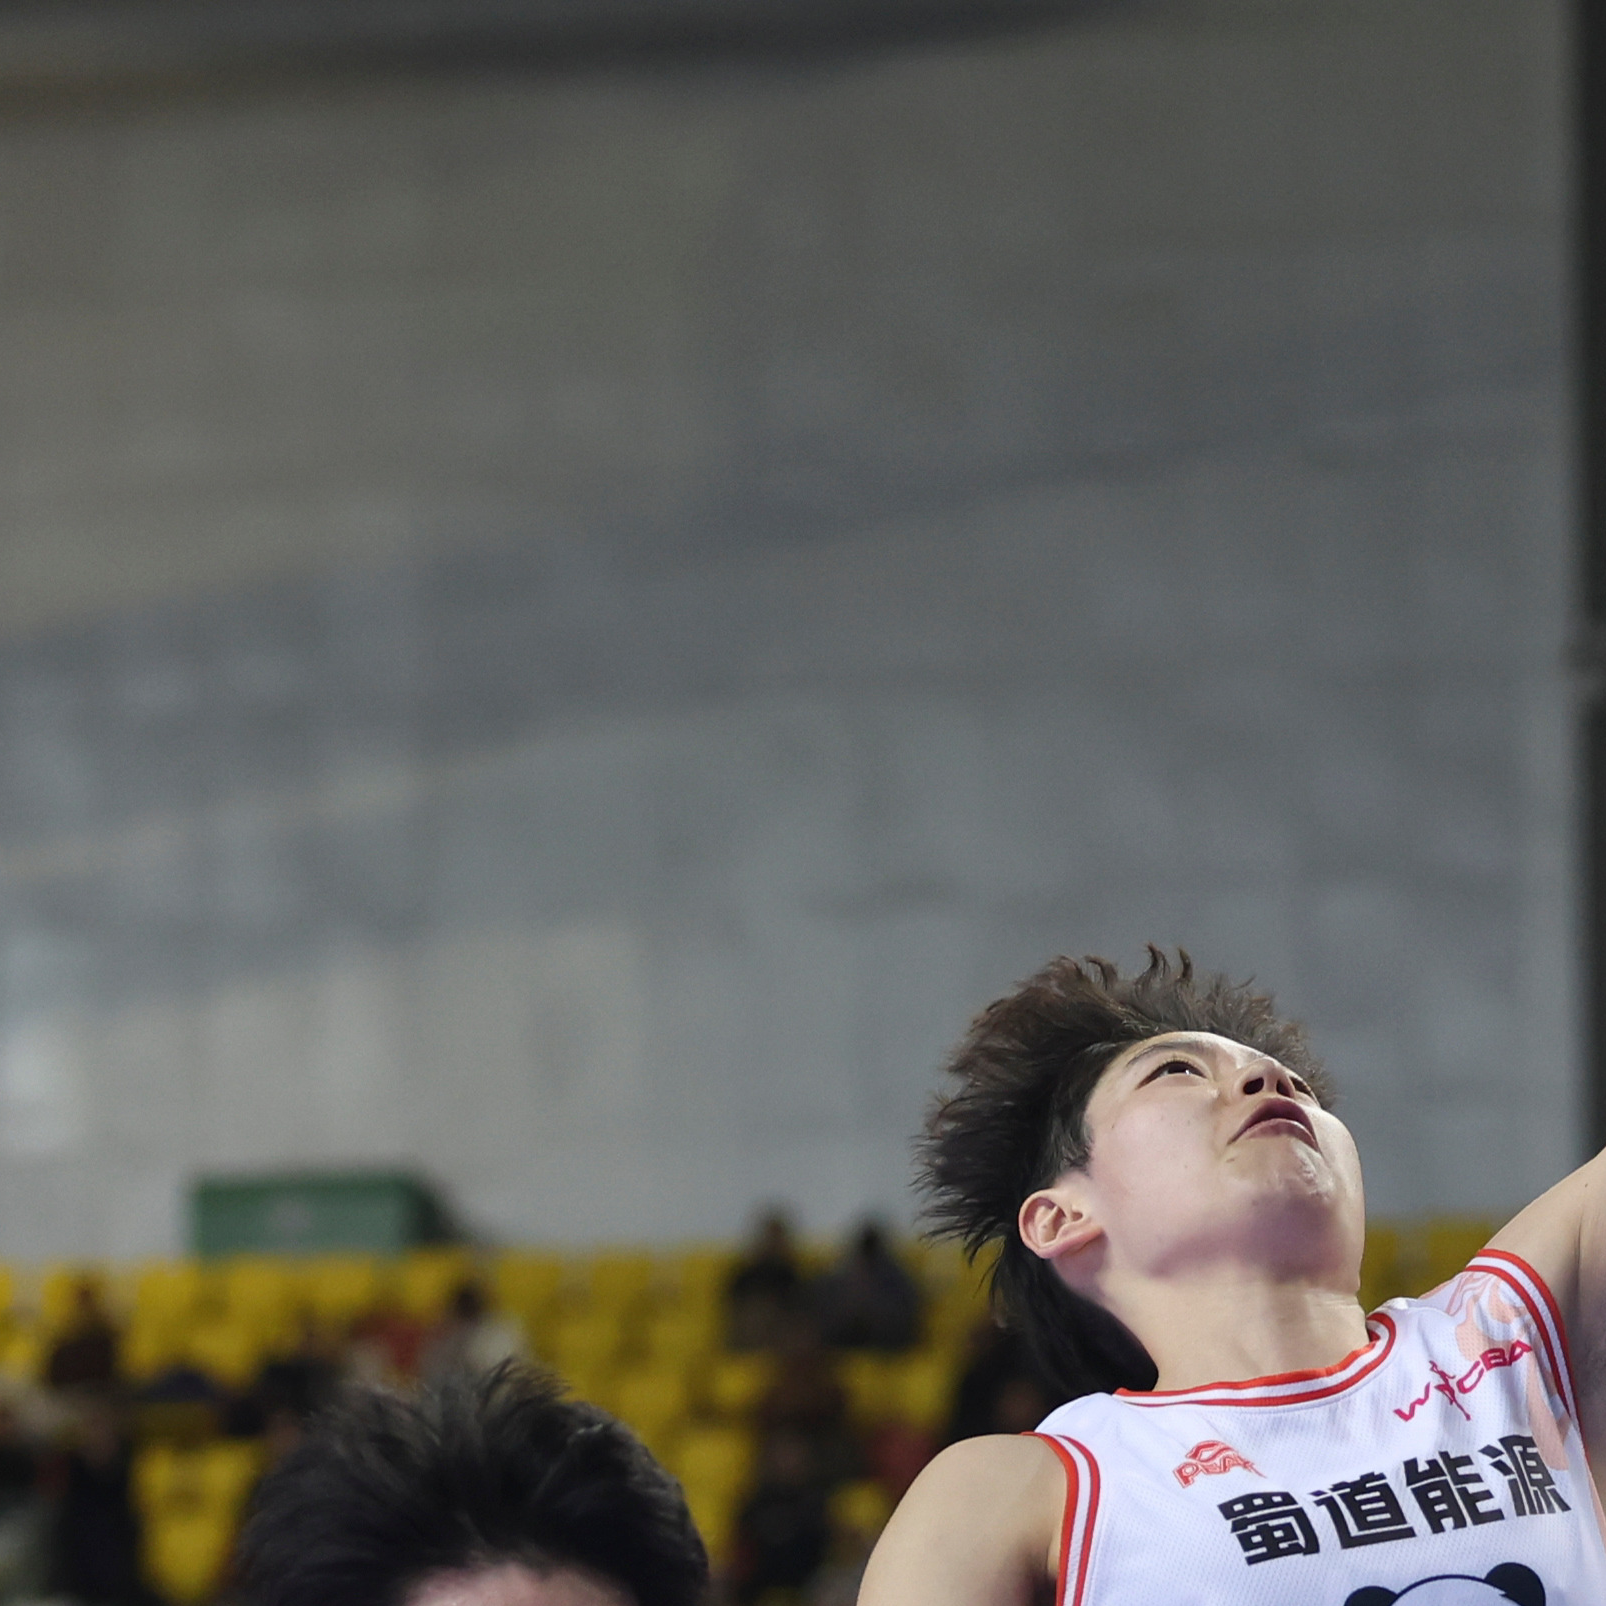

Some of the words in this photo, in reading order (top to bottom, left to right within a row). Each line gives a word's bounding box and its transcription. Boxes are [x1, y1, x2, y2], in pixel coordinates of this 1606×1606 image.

[1393, 1339, 1533, 1424] WCBA
[1217, 1434, 1572, 1566] 蜀道能源
